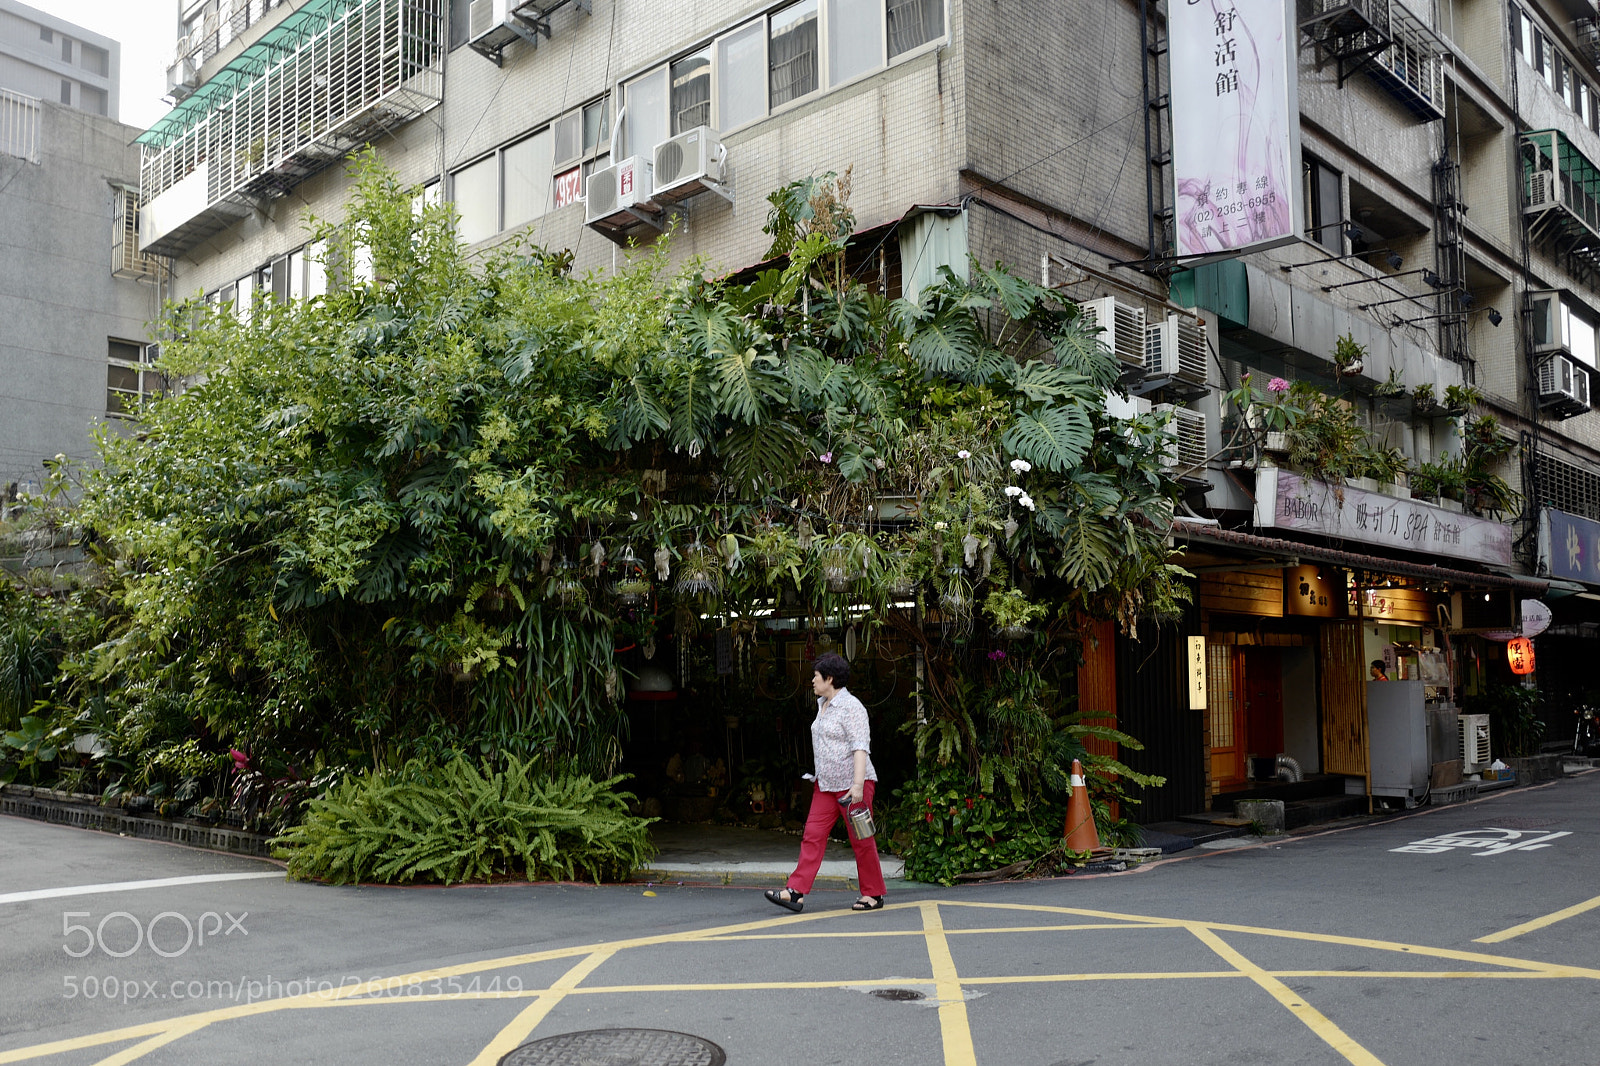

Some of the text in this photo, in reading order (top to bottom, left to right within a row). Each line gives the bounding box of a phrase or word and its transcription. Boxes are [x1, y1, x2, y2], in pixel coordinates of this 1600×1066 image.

[1213, 7, 1239, 98] 舒活館
[1197, 176, 1269, 208] 預約專線
[1202, 211, 1266, 238] 請上二樓
[1284, 497, 1318, 522] BABOR
[1356, 503, 1399, 535] 吸引力
[1403, 513, 1429, 541] SPA
